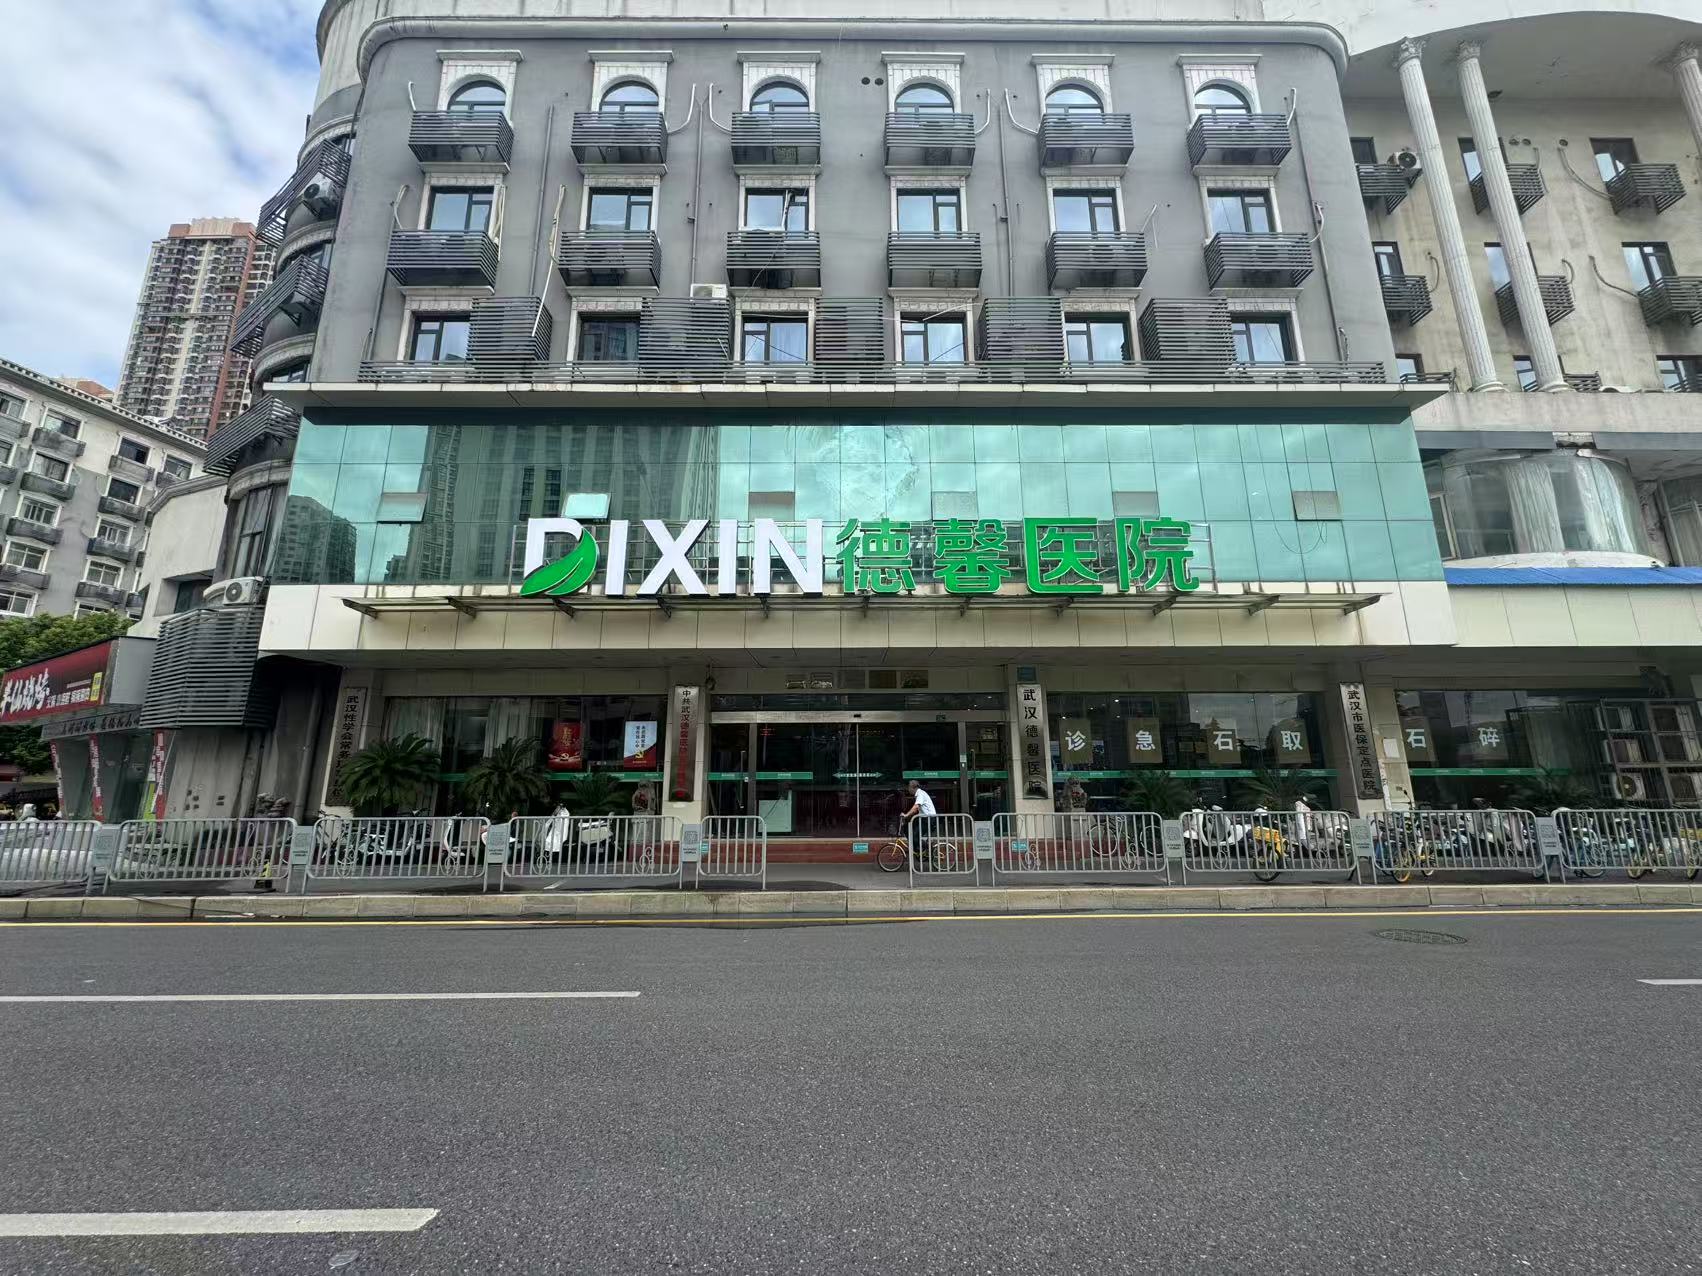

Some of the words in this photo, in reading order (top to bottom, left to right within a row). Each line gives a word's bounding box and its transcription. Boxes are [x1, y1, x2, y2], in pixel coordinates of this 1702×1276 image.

[521, 518, 824, 597] DIXIN
[836, 517, 1199, 595] 德馨医院
[1023, 689, 1041, 793] 武汉德馨医院
[1065, 730, 1086, 752] 诊
[1136, 730, 1156, 751] 急
[1213, 731, 1234, 751] 石
[1281, 731, 1303, 752] 取
[1347, 689, 1377, 790] 武汉市医保定点医院
[1406, 729, 1427, 749] 石
[1478, 727, 1500, 747] 碎
